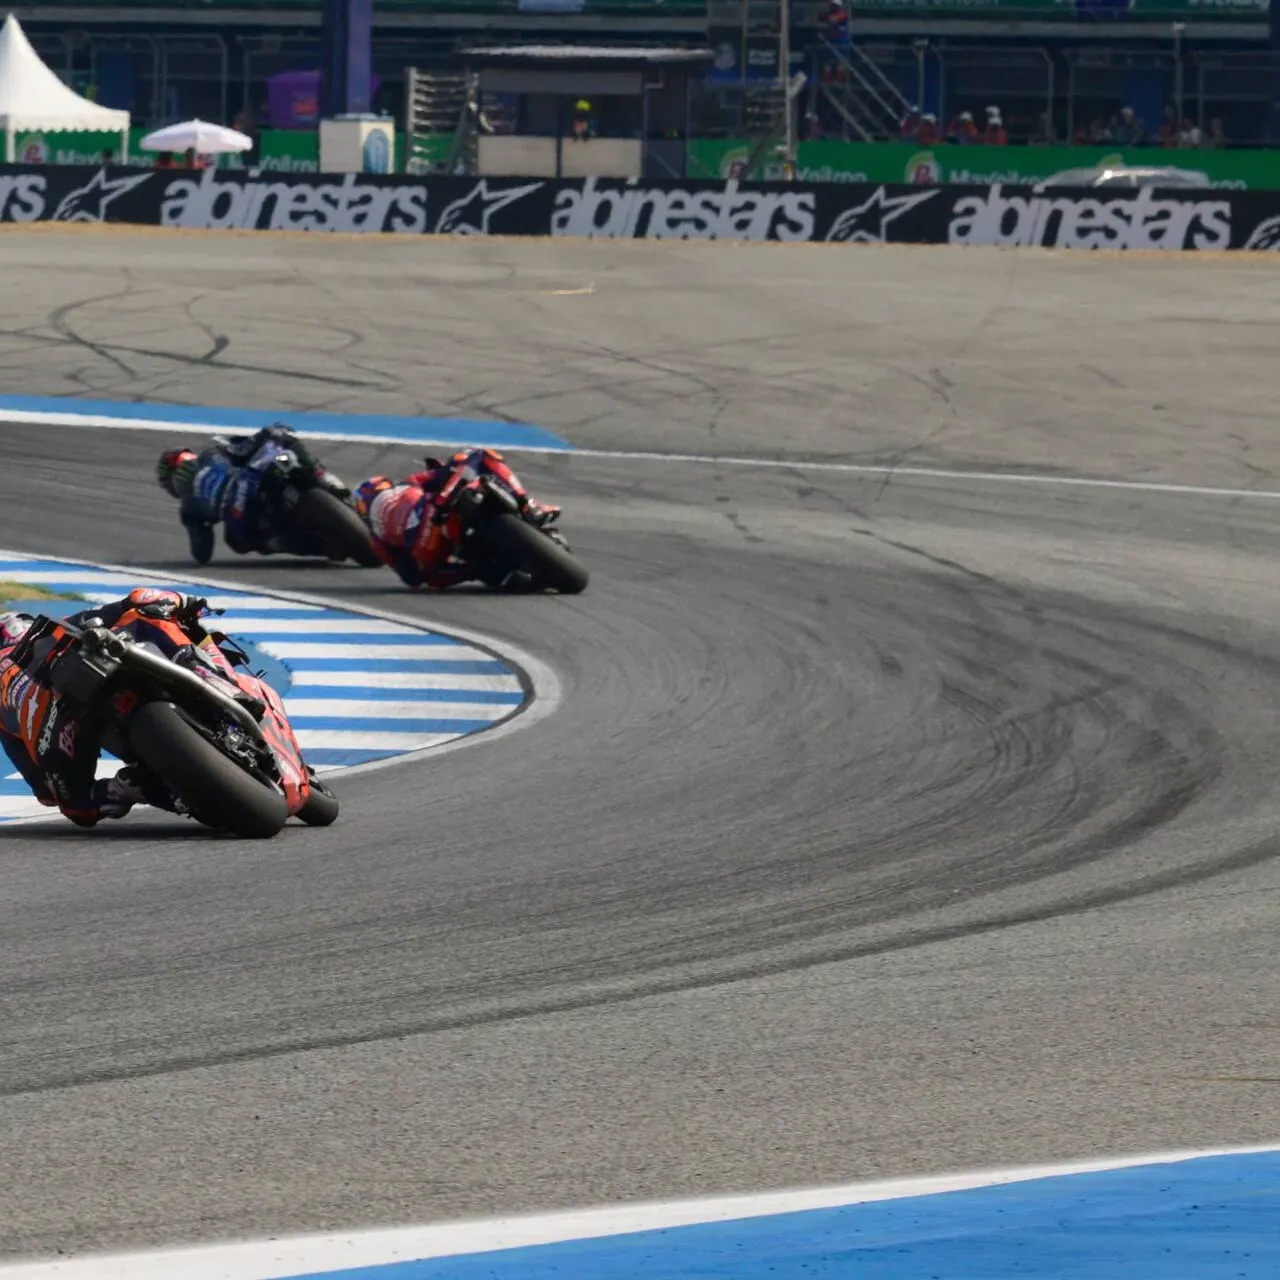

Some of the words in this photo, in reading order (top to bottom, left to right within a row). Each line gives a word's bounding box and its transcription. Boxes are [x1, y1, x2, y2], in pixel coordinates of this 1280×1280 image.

[160, 164, 428, 234] alpinestars
[550, 174, 815, 242] alpinestars
[948, 182, 1231, 251] alpinestars
